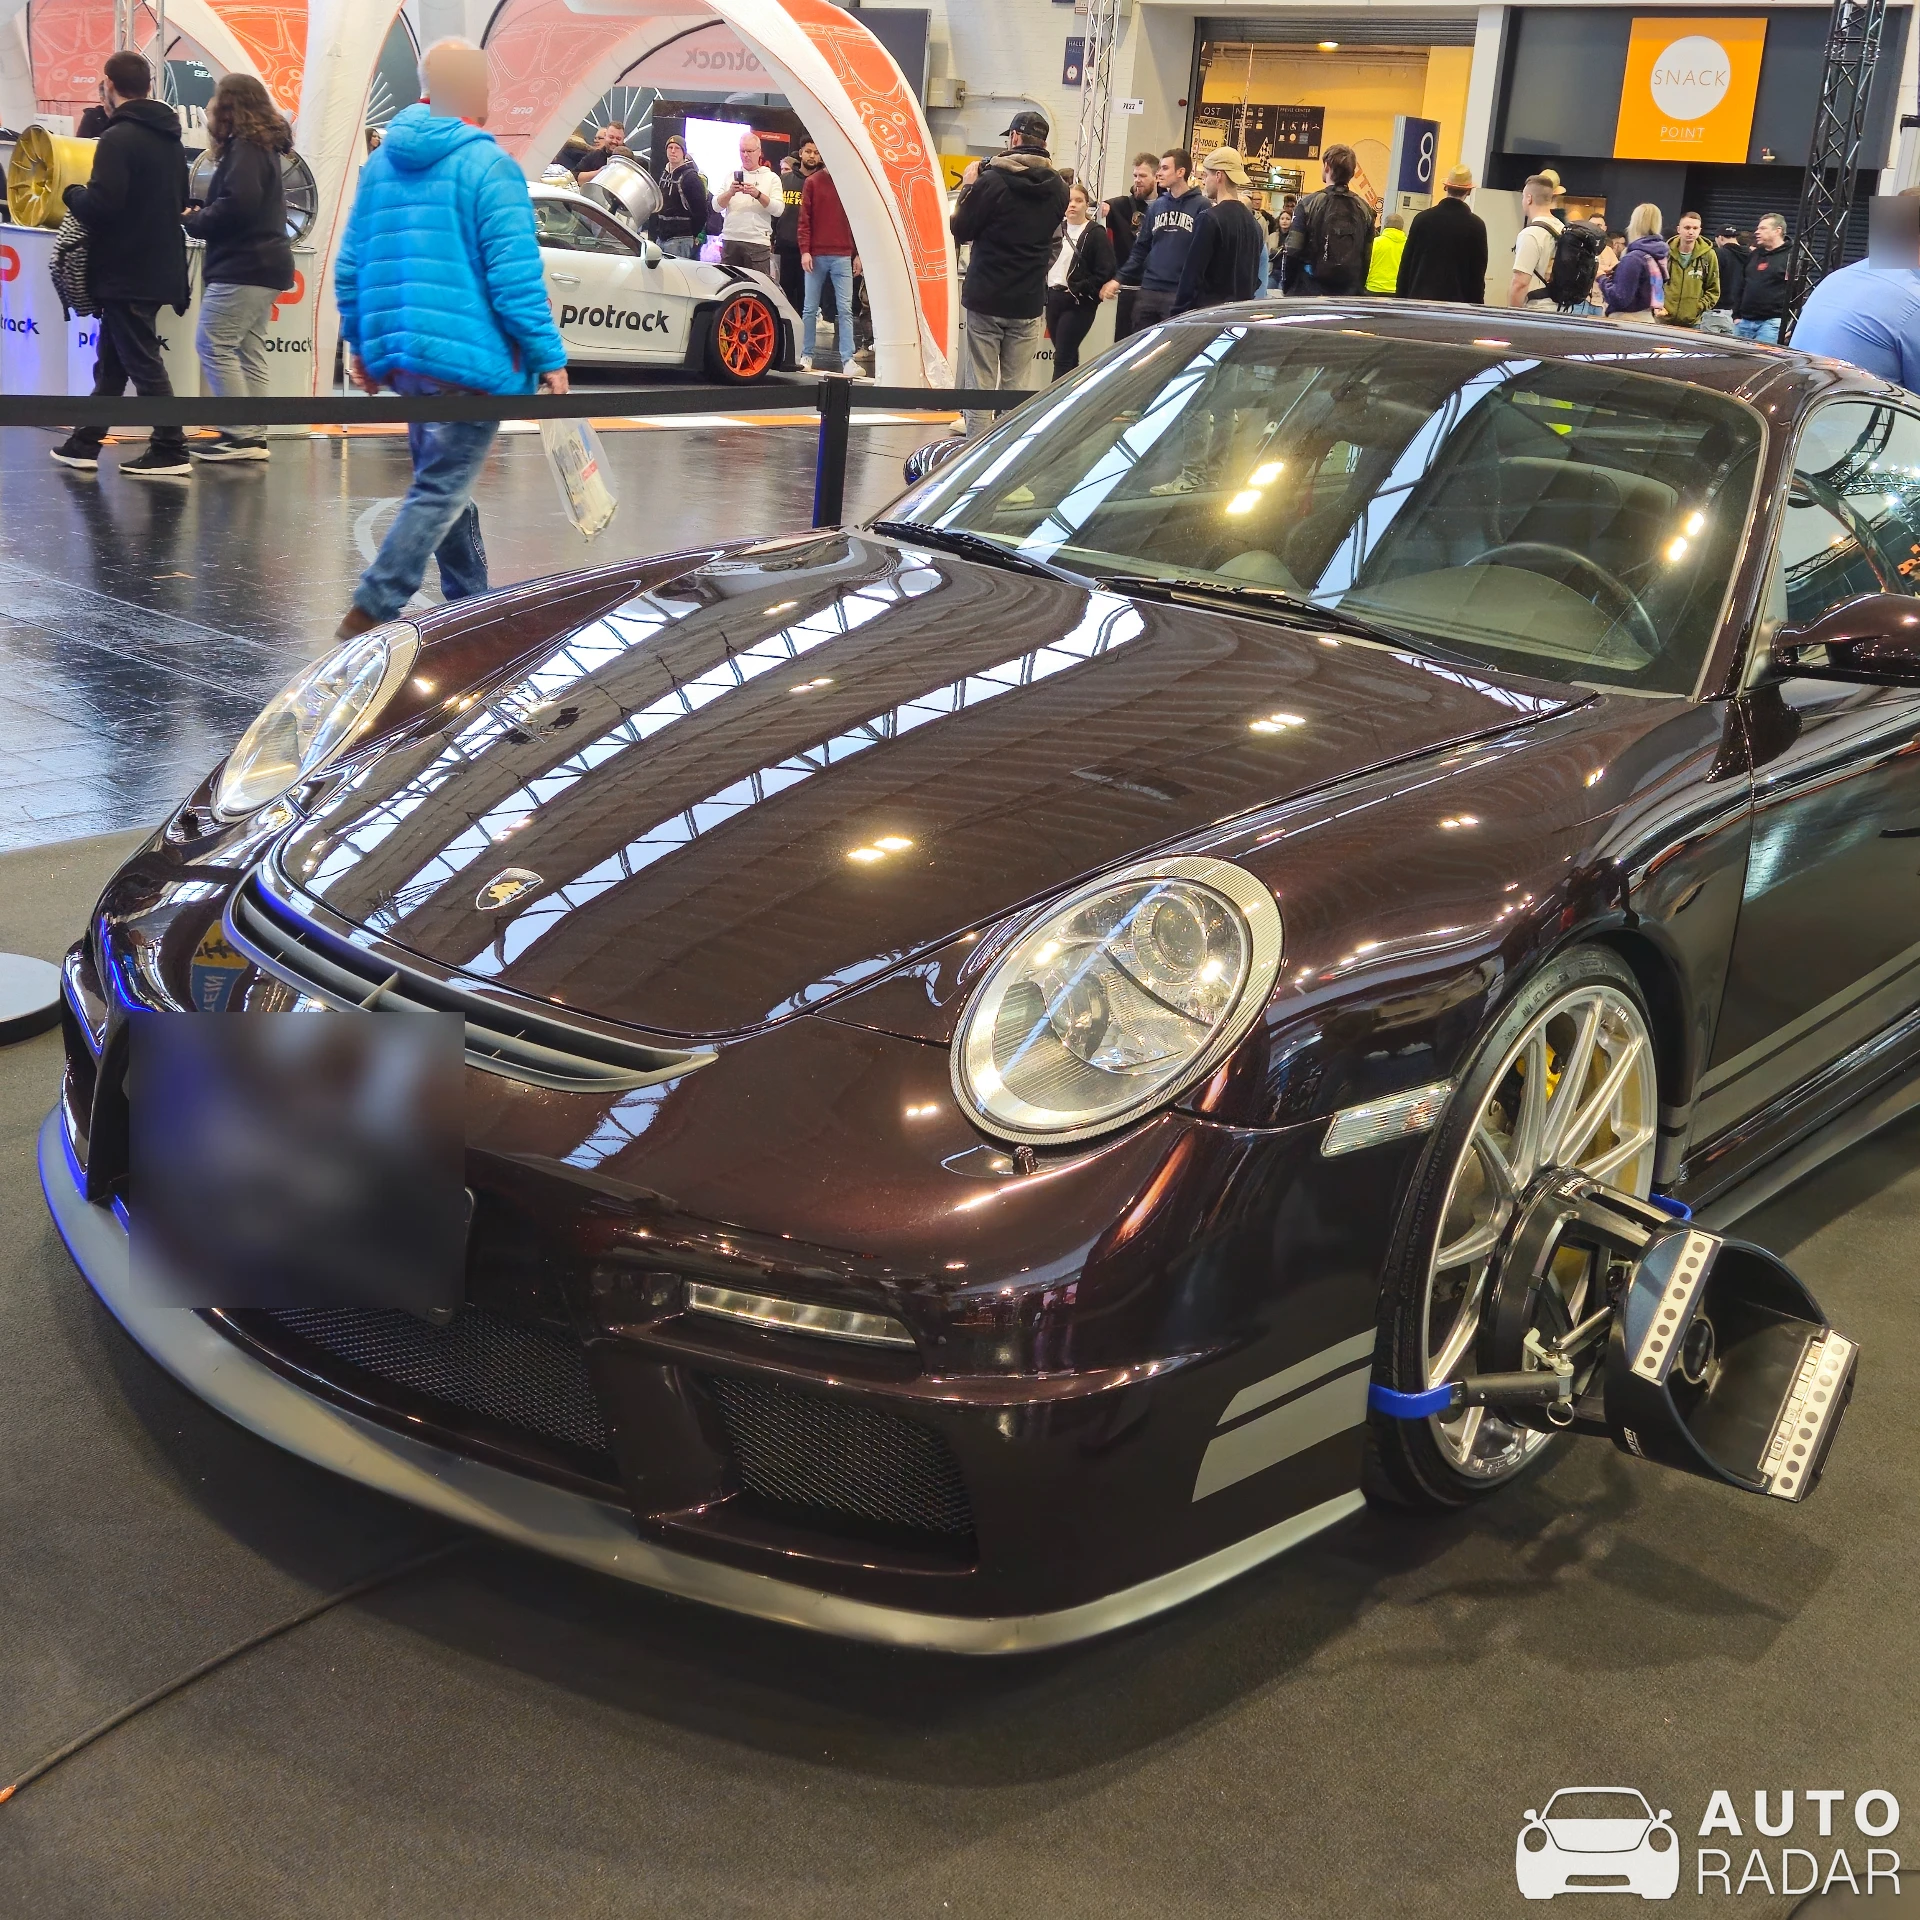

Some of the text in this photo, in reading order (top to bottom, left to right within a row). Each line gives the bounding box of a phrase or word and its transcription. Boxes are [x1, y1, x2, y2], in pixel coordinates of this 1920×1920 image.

[1653, 69, 1727, 86] SNACK
[1203, 106, 1221, 116] OST
[1660, 126, 1706, 138] POINT
[1417, 131, 1434, 183] 8
[0, 313, 40, 335] track
[559, 304, 670, 334] protrack
[264, 336, 312, 353] otrack
